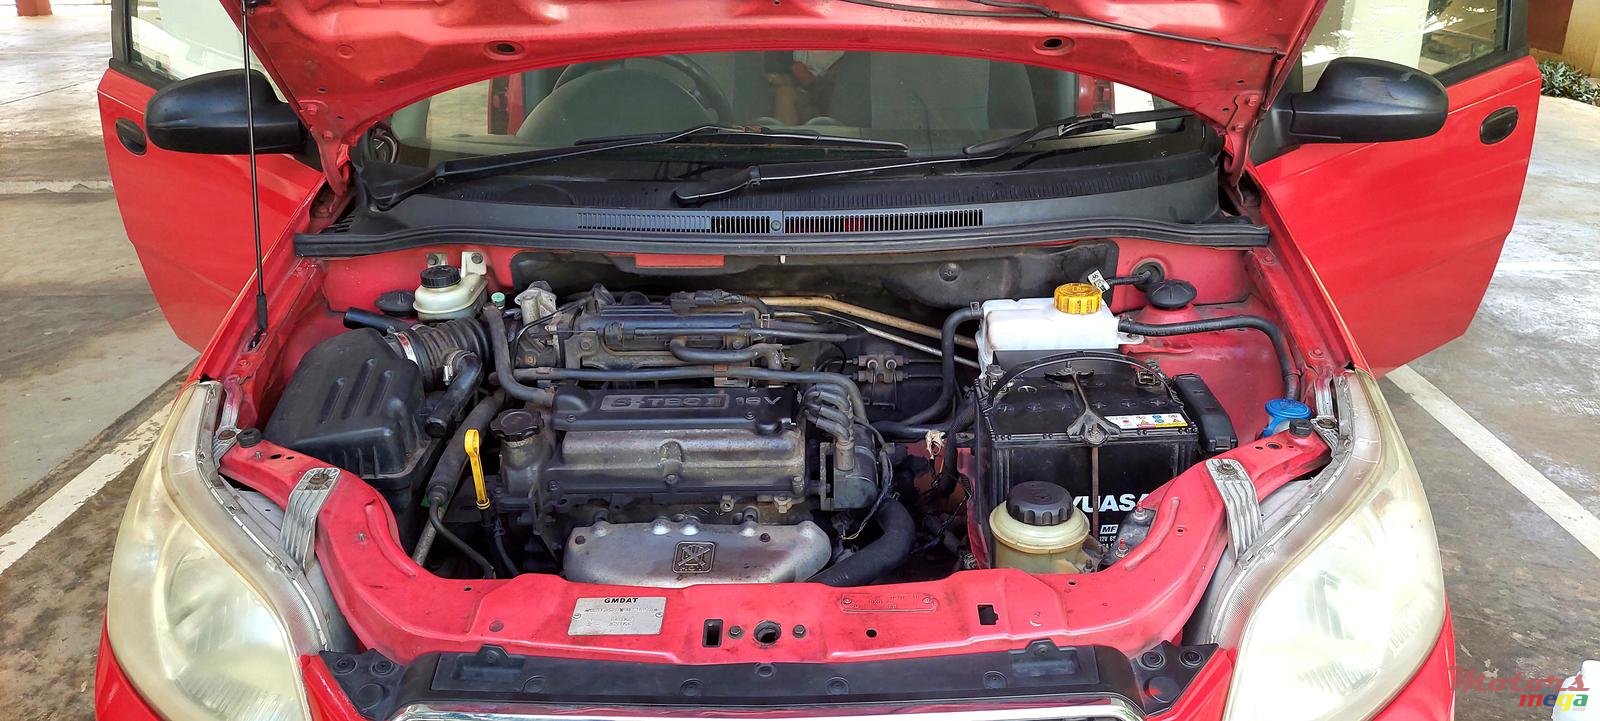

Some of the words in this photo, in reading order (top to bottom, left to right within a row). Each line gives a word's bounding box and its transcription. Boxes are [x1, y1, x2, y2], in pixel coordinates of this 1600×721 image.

[735, 396, 782, 406] 16V
[1072, 493, 1150, 513] UAS
[1101, 525, 1118, 534] MF
